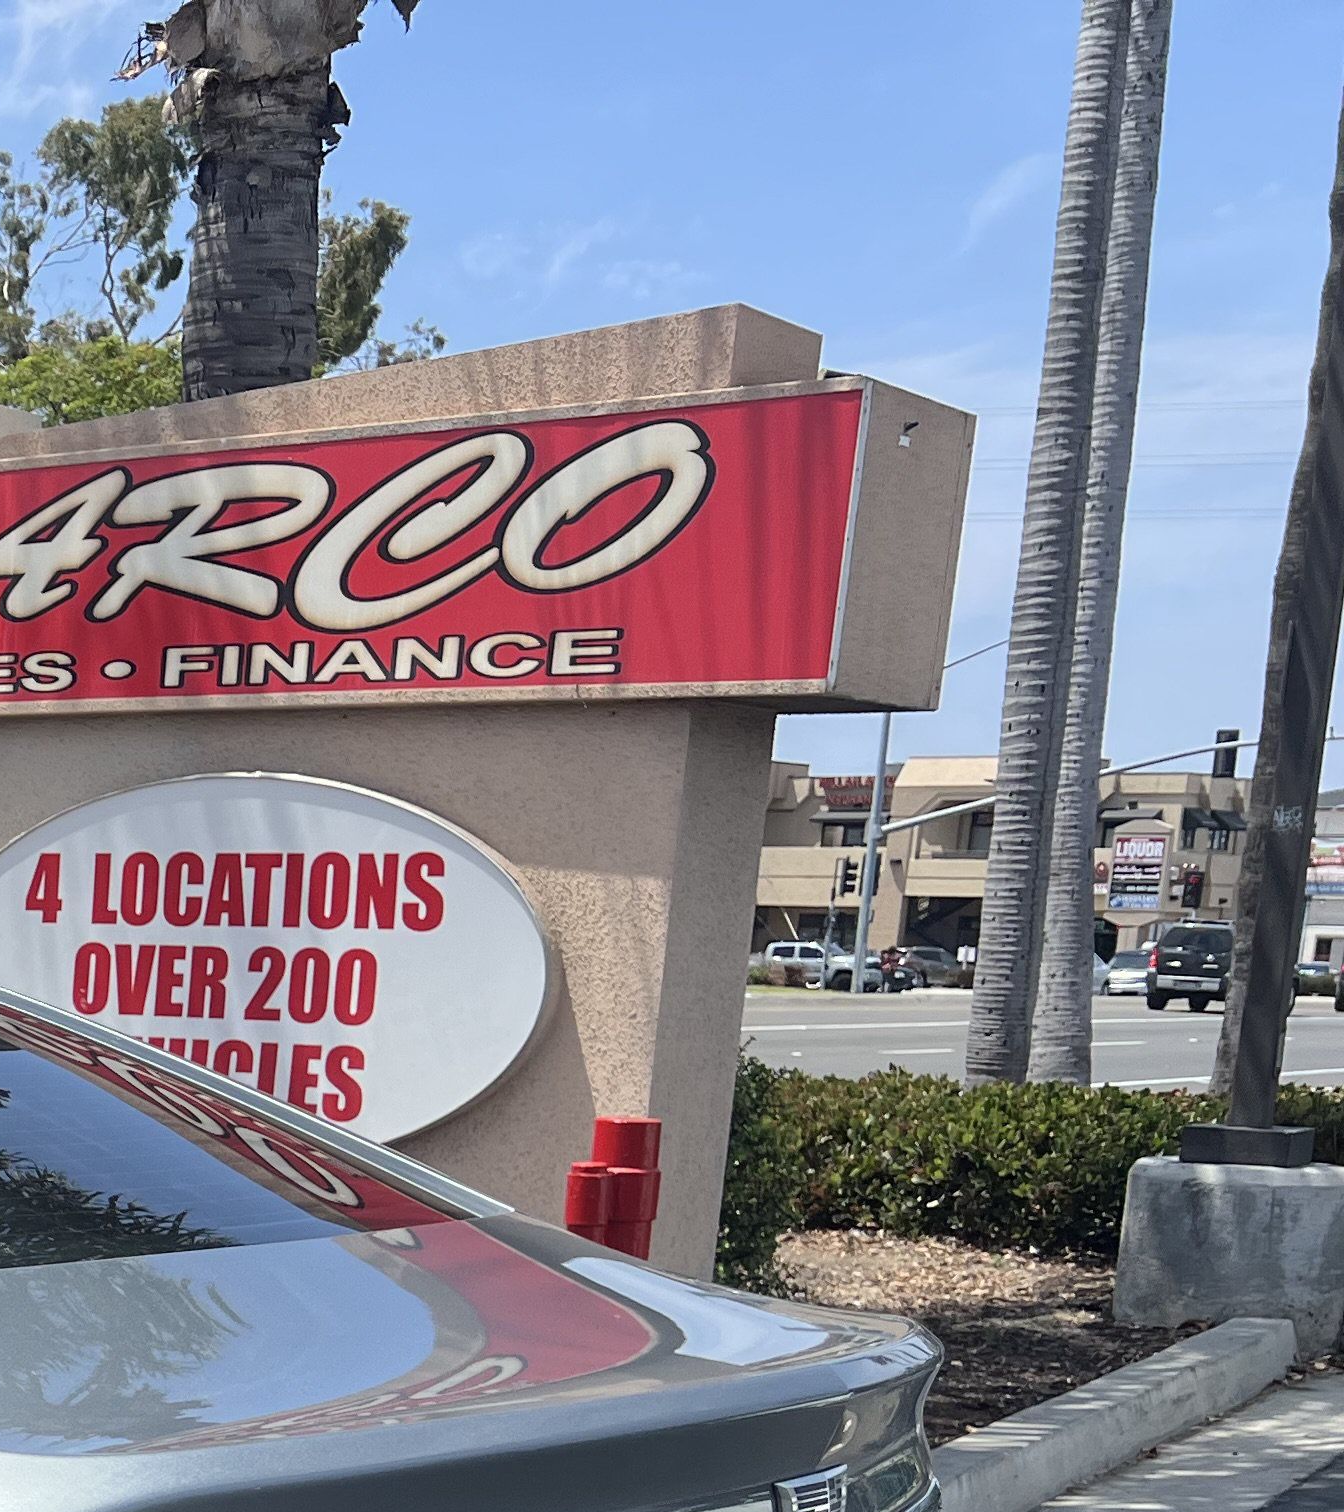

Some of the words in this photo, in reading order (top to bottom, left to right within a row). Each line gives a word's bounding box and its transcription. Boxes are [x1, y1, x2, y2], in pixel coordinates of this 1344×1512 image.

[162, 627, 624, 690] FINANCE
[1116, 841, 1165, 858] LIQUOR
[25, 852, 63, 923] 4
[91, 851, 446, 932] LOCATIONS
[72, 941, 229, 1020] OVER
[243, 946, 378, 1026] 200
